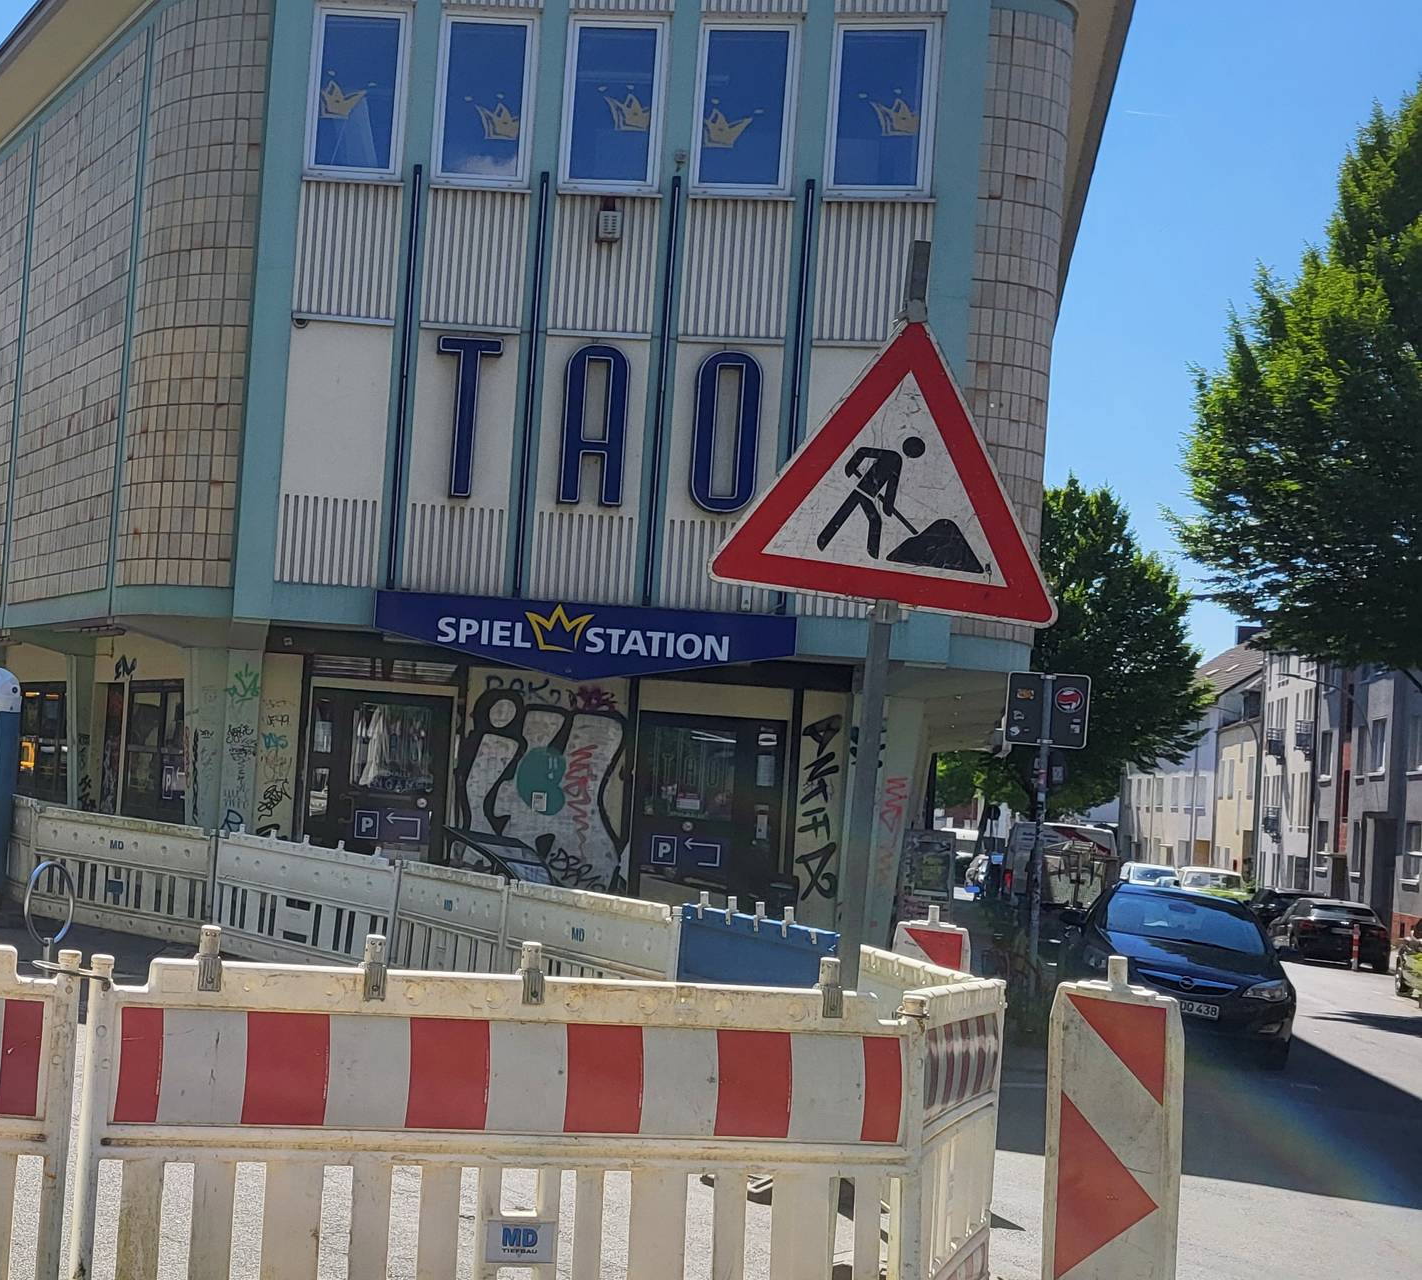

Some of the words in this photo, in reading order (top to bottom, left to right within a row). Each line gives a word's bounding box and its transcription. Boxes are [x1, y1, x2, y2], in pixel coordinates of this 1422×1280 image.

[437, 336, 763, 512] TAO
[436, 617, 532, 648] SPIEL
[585, 627, 730, 662] STATION
[361, 816, 374, 832] P
[109, 839, 124, 850] MD
[658, 842, 671, 858] P
[571, 927, 585, 942] MD
[1196, 1004, 1218, 1017] 438
[501, 1227, 538, 1248] MD
